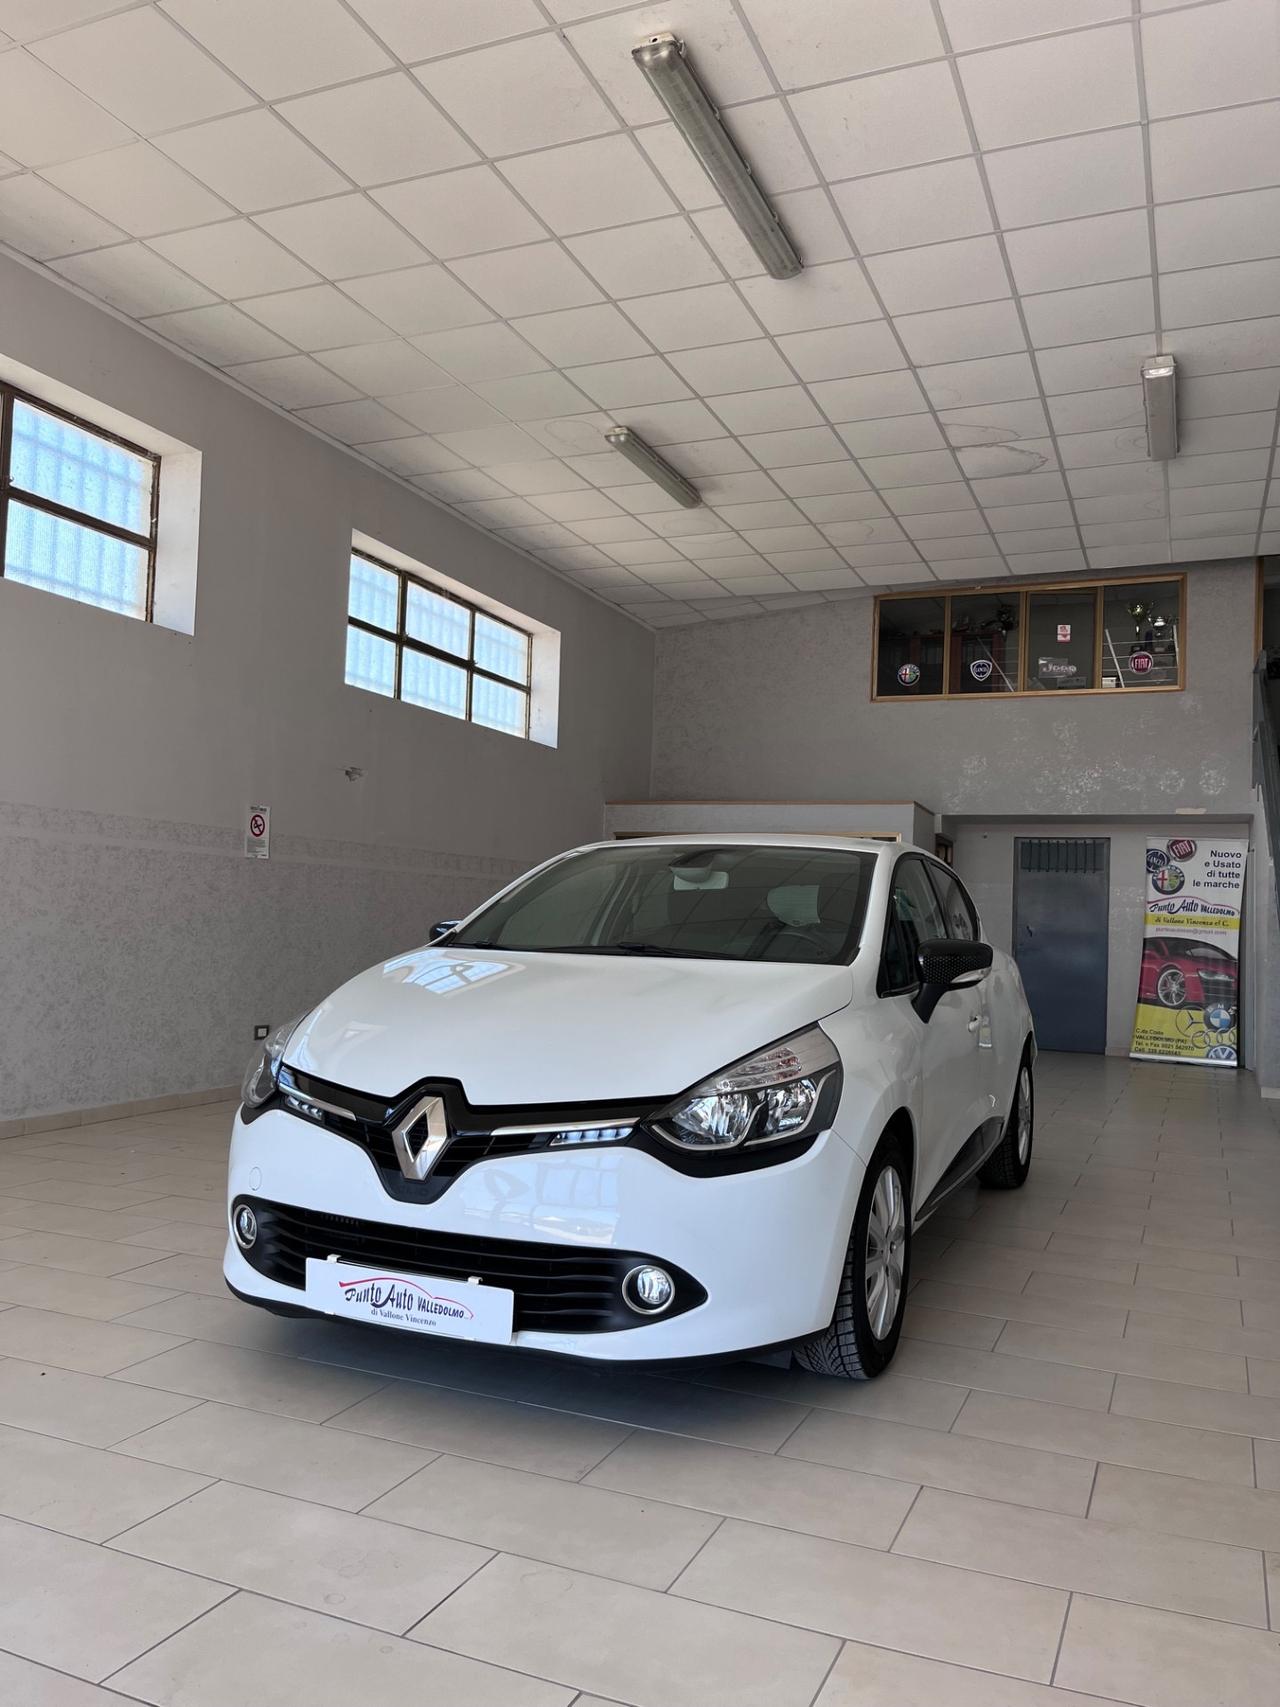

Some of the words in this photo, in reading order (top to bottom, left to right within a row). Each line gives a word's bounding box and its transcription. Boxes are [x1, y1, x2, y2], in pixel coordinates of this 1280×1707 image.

[1135, 658, 1148, 670] FIAT
[1173, 840, 1190, 857] FIAT
[1210, 850, 1242, 858] Nuovo
[1212, 860, 1241, 868] Usato
[1206, 870, 1216, 878] di
[1204, 880, 1240, 888] marche
[1149, 902, 1175, 912] Punto
[1168, 899, 1199, 914] Auto
[1200, 904, 1235, 916] VALLEDOLMO
[345, 1283, 381, 1304] Punto
[371, 1284, 414, 1311] Auto
[417, 1296, 464, 1318] VALLEDOLMO
[371, 1308, 378, 1317] di
[380, 1310, 404, 1321] Vallone
[405, 1313, 437, 1326] Vincenzo
